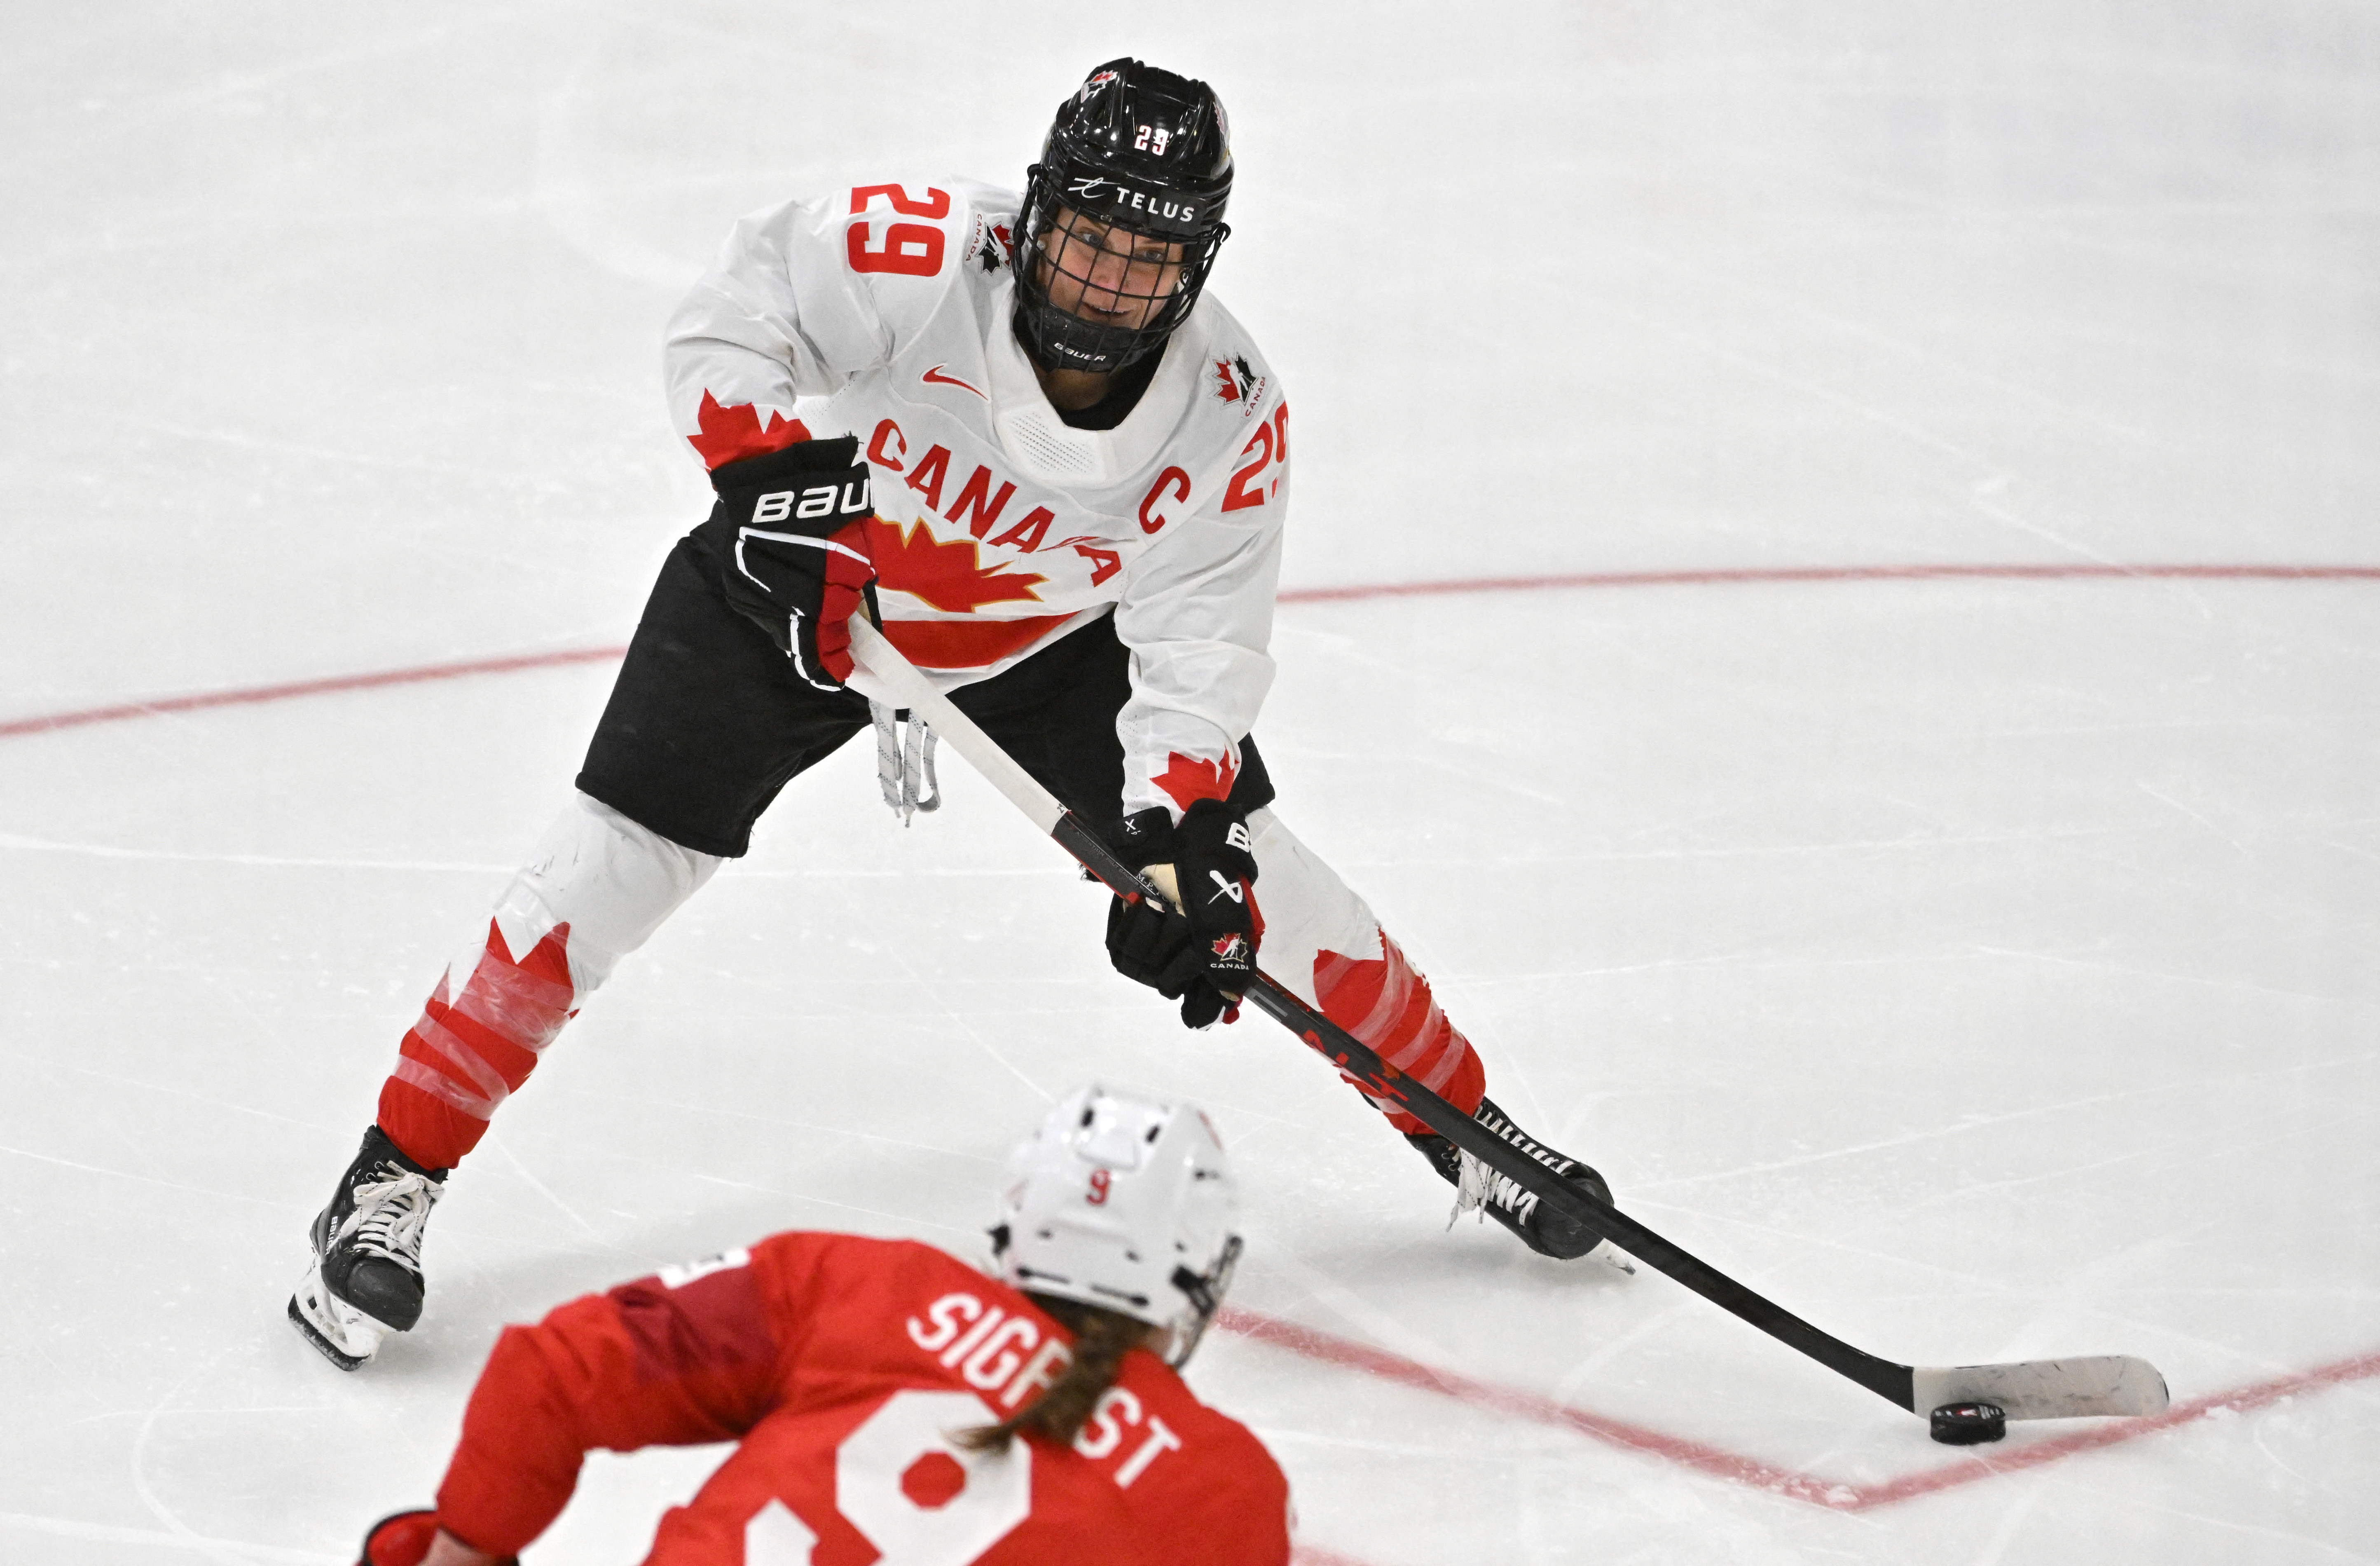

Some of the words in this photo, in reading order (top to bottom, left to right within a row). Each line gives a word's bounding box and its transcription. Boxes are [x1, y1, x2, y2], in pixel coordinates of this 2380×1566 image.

[1135, 125, 1169, 156] 29
[1116, 186, 1195, 223] TELUS
[847, 183, 951, 277] 29
[966, 214, 982, 261] CANADA
[1054, 342, 1107, 361] BAUER
[1245, 376, 1266, 417] CANADA
[752, 478, 875, 523] BAU
[866, 419, 1122, 588] CANAA
[1139, 466, 1191, 535] C
[1086, 1167, 1112, 1206] 9
[324, 1216, 338, 1256] BAUER
[906, 1292, 1182, 1489] SIGRST
